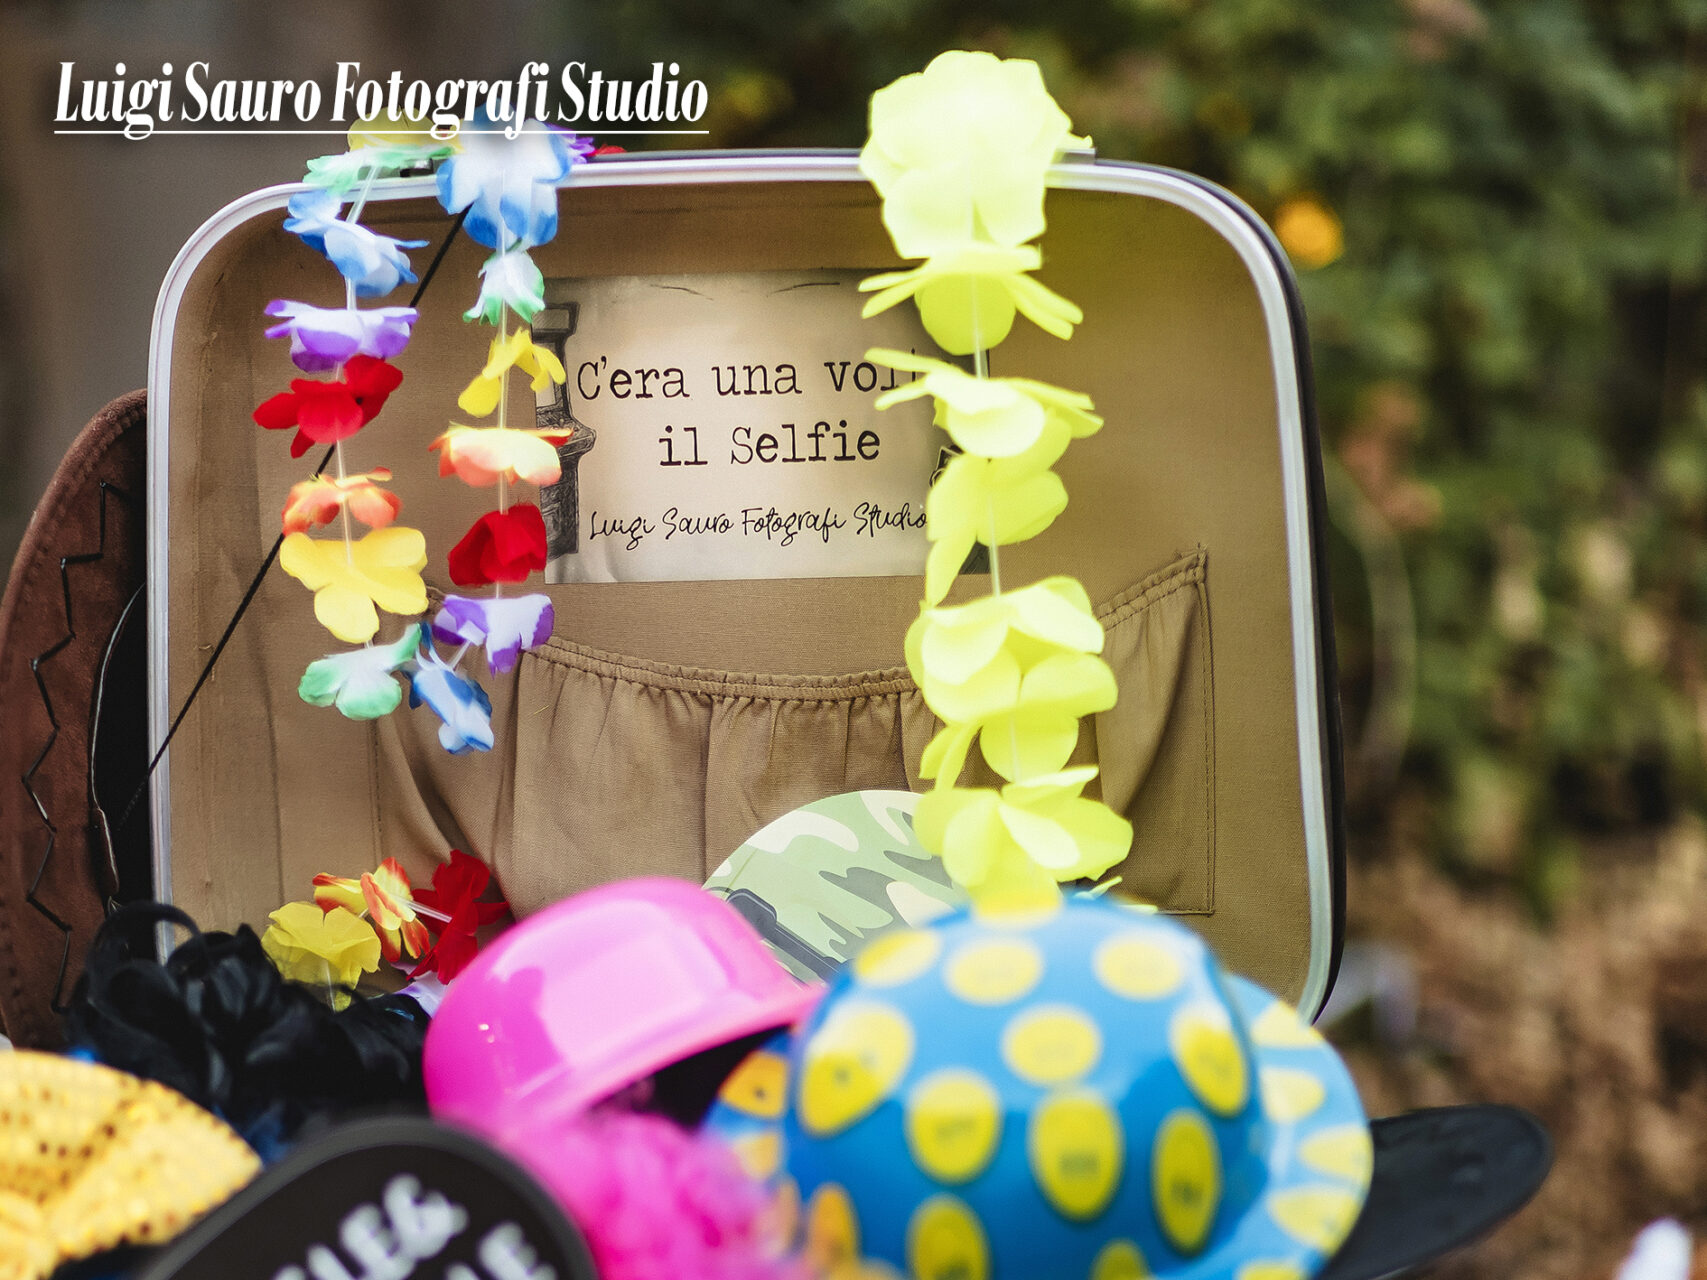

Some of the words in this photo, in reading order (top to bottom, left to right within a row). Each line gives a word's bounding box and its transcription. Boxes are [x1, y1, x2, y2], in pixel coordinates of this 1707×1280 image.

[577, 355, 691, 401] C'era
[711, 359, 802, 396] una
[658, 425, 708, 467] il
[730, 420, 881, 466] Selfie
[589, 512, 655, 551] Luigi
[662, 507, 733, 540] Sauro
[741, 505, 847, 547] Fotografi
[854, 502, 928, 533] Studio
